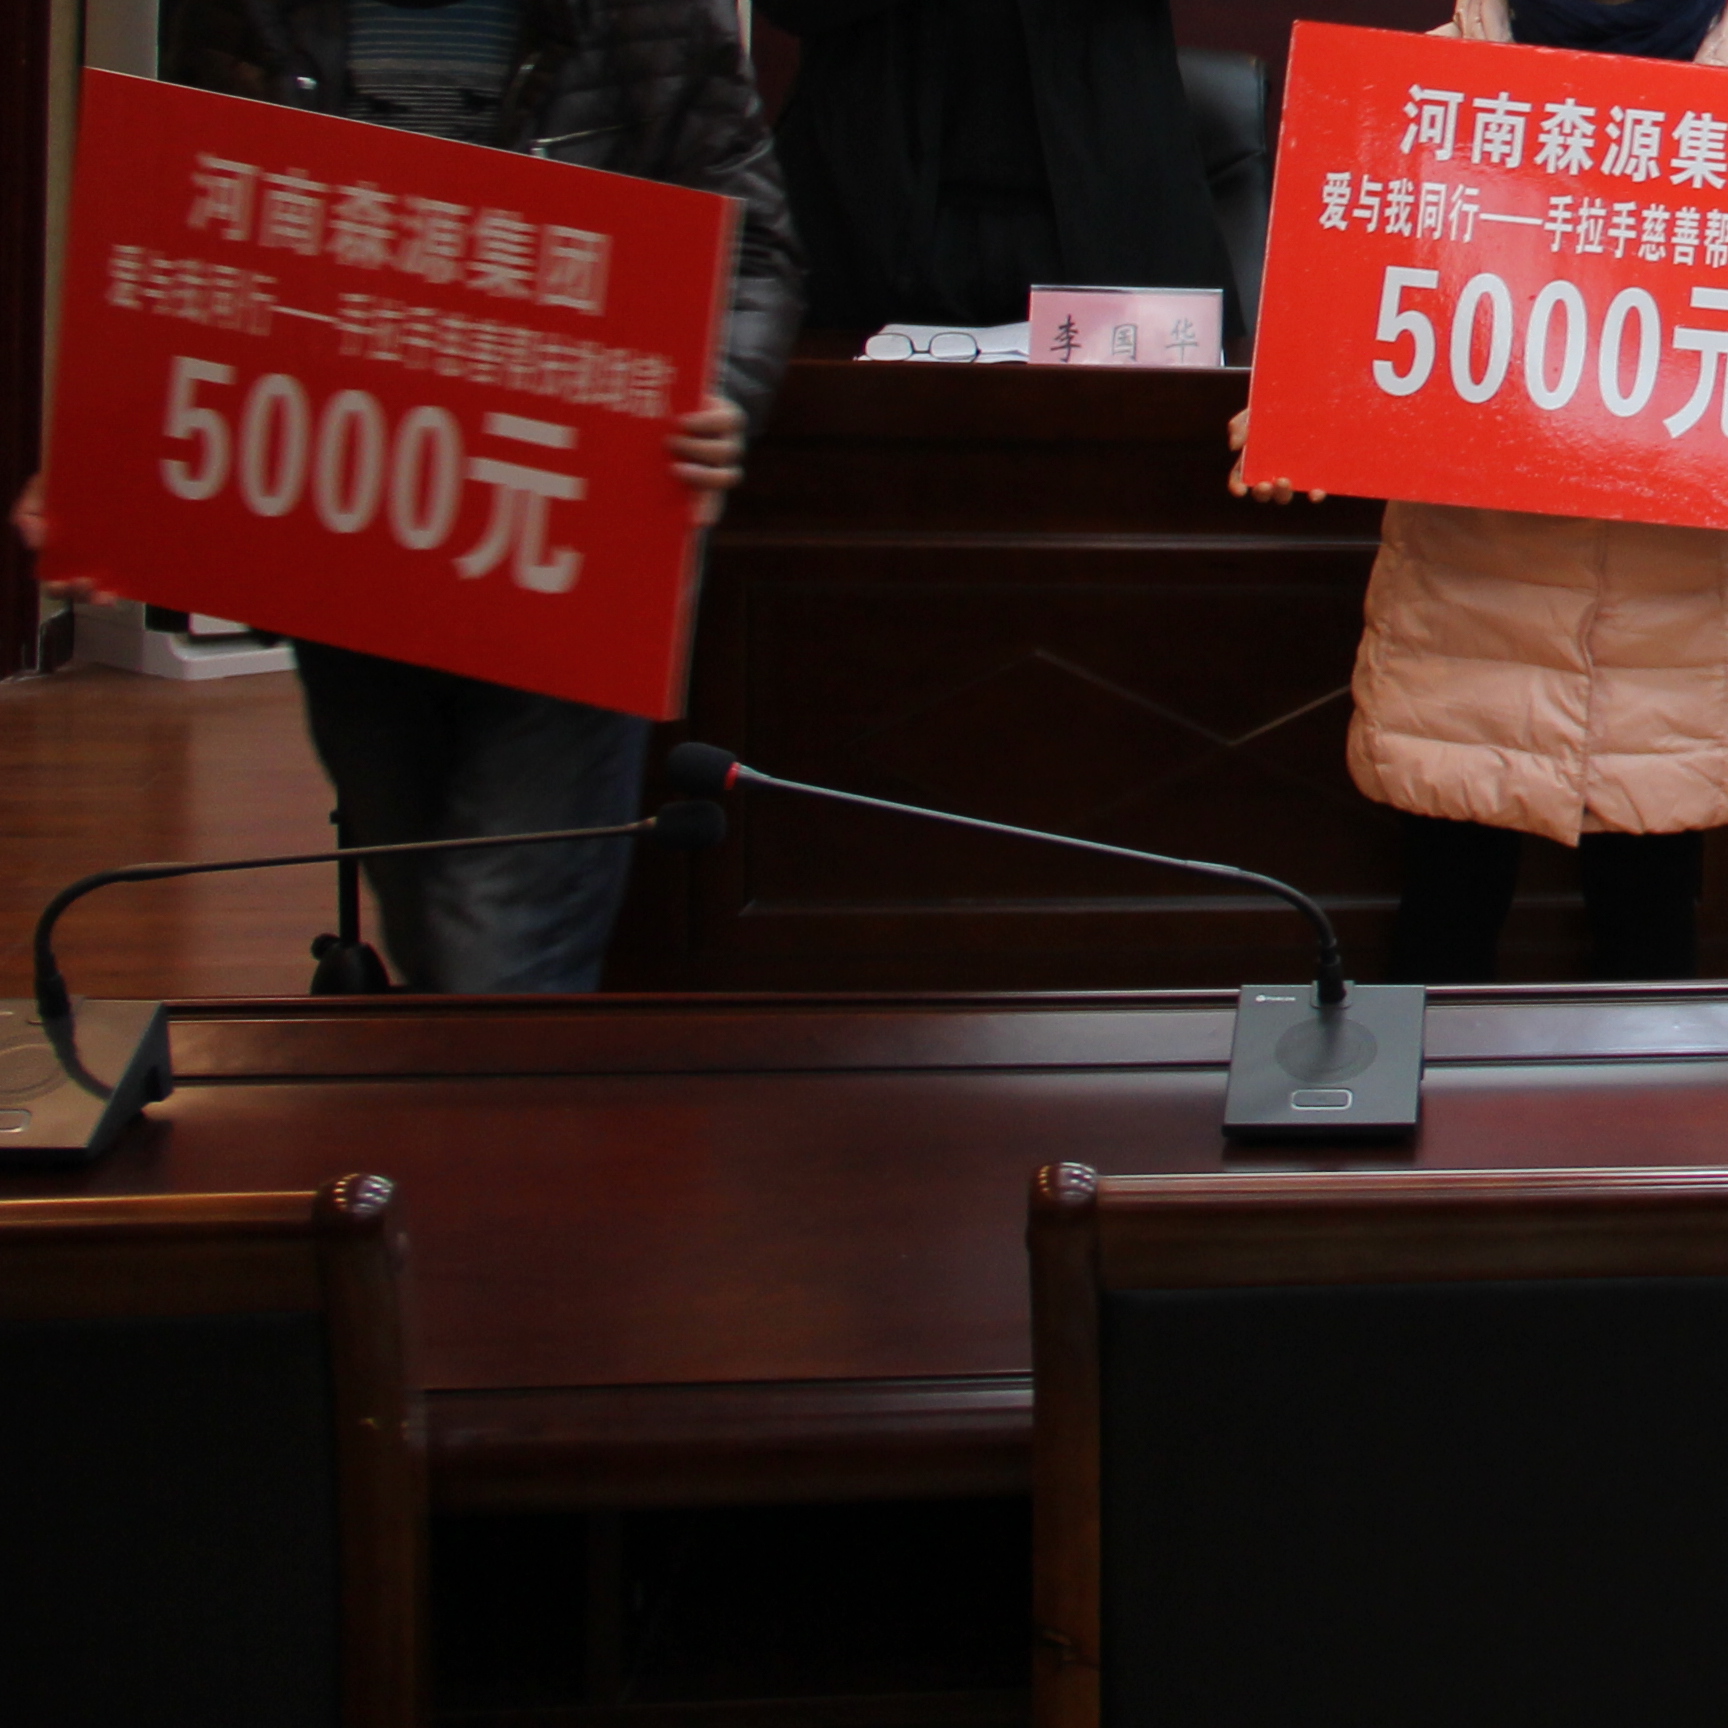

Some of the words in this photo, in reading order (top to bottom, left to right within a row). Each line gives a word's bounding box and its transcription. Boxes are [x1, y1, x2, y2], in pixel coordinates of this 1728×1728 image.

[187, 152, 613, 316] 河南森源集团
[1050, 313, 1200, 363] 李国华
[161, 355, 587, 594] 5000元
